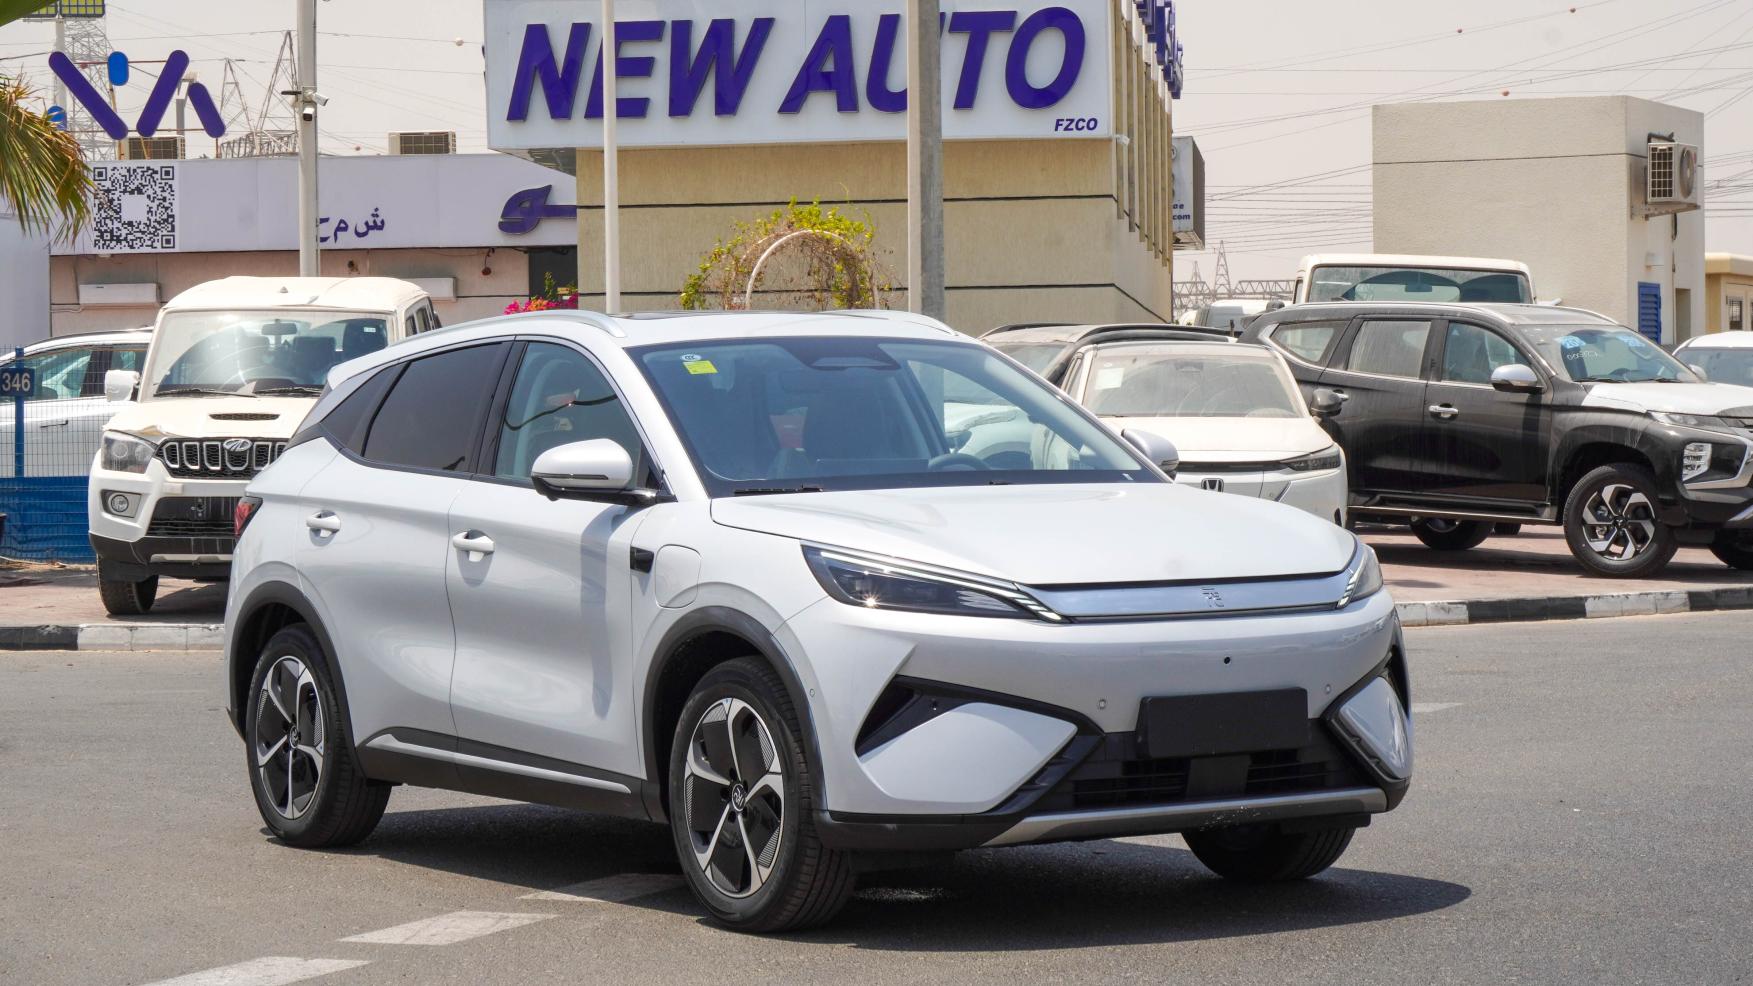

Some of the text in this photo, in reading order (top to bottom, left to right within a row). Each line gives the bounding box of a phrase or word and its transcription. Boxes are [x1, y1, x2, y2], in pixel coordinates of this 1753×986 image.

[506, 17, 776, 122] NEW
[777, 6, 1086, 114] AUTO
[1054, 117, 1098, 132] FZCO
[1, 372, 31, 392] 346
